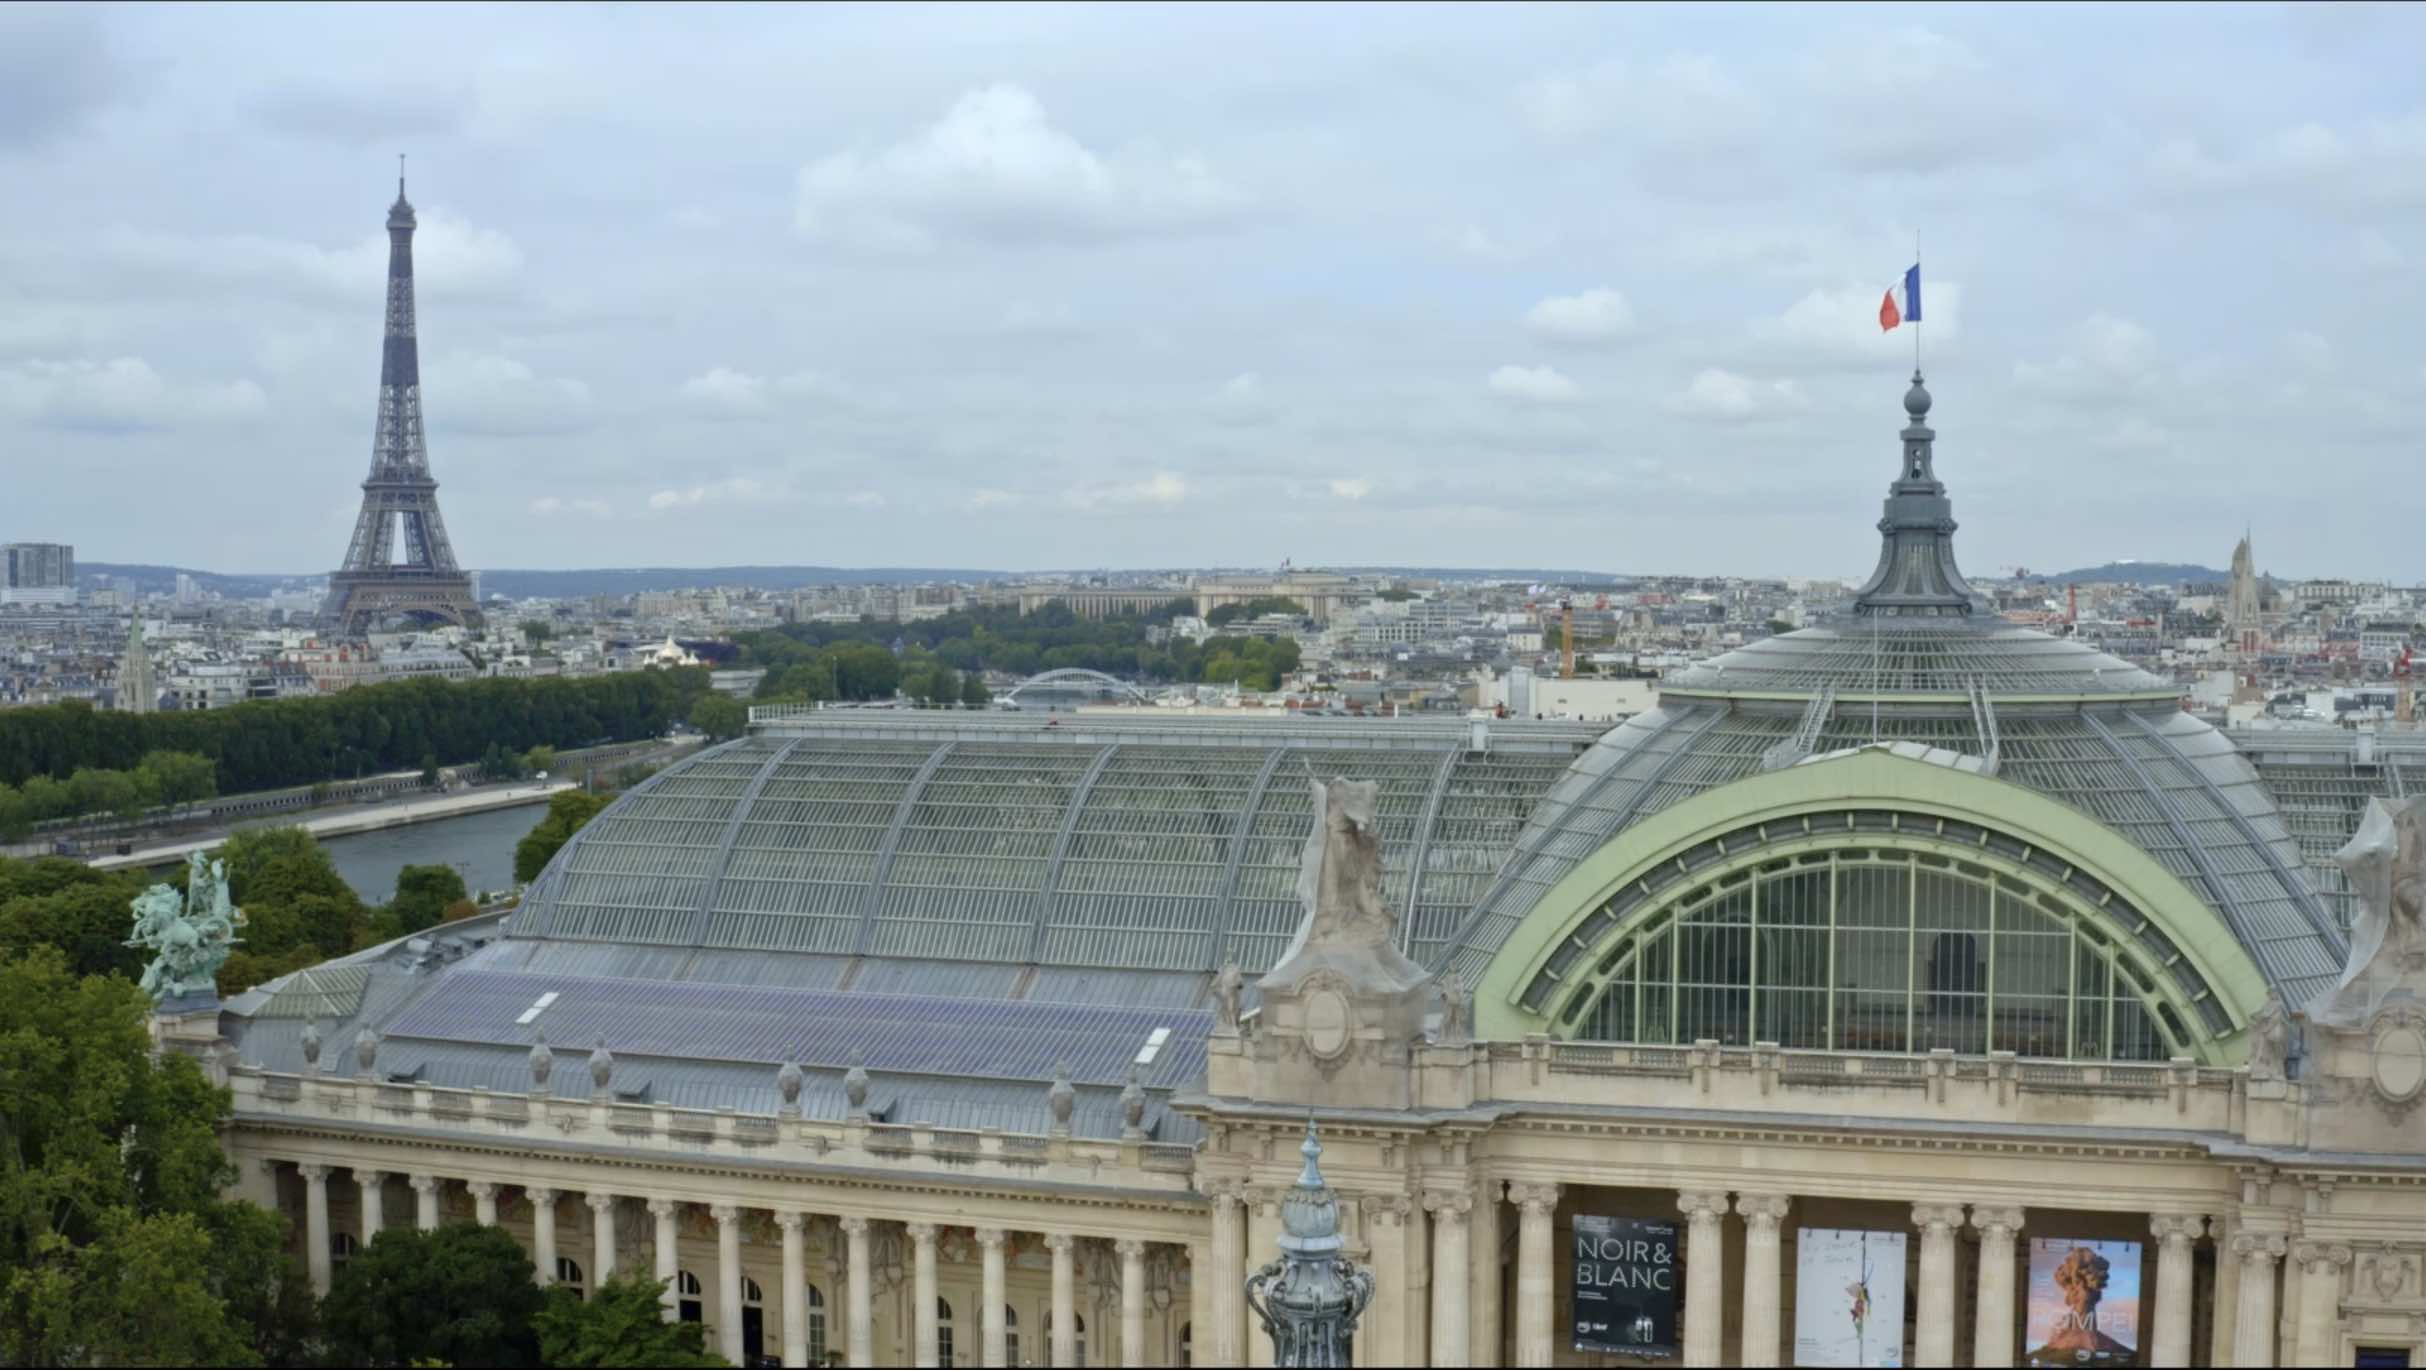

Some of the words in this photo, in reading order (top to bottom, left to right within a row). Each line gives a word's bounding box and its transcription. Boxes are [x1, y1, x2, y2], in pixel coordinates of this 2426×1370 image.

[1578, 1238, 1648, 1262] NOIR
[1653, 1242, 1672, 1264] &
[1577, 1264, 1671, 1290] BLANC
